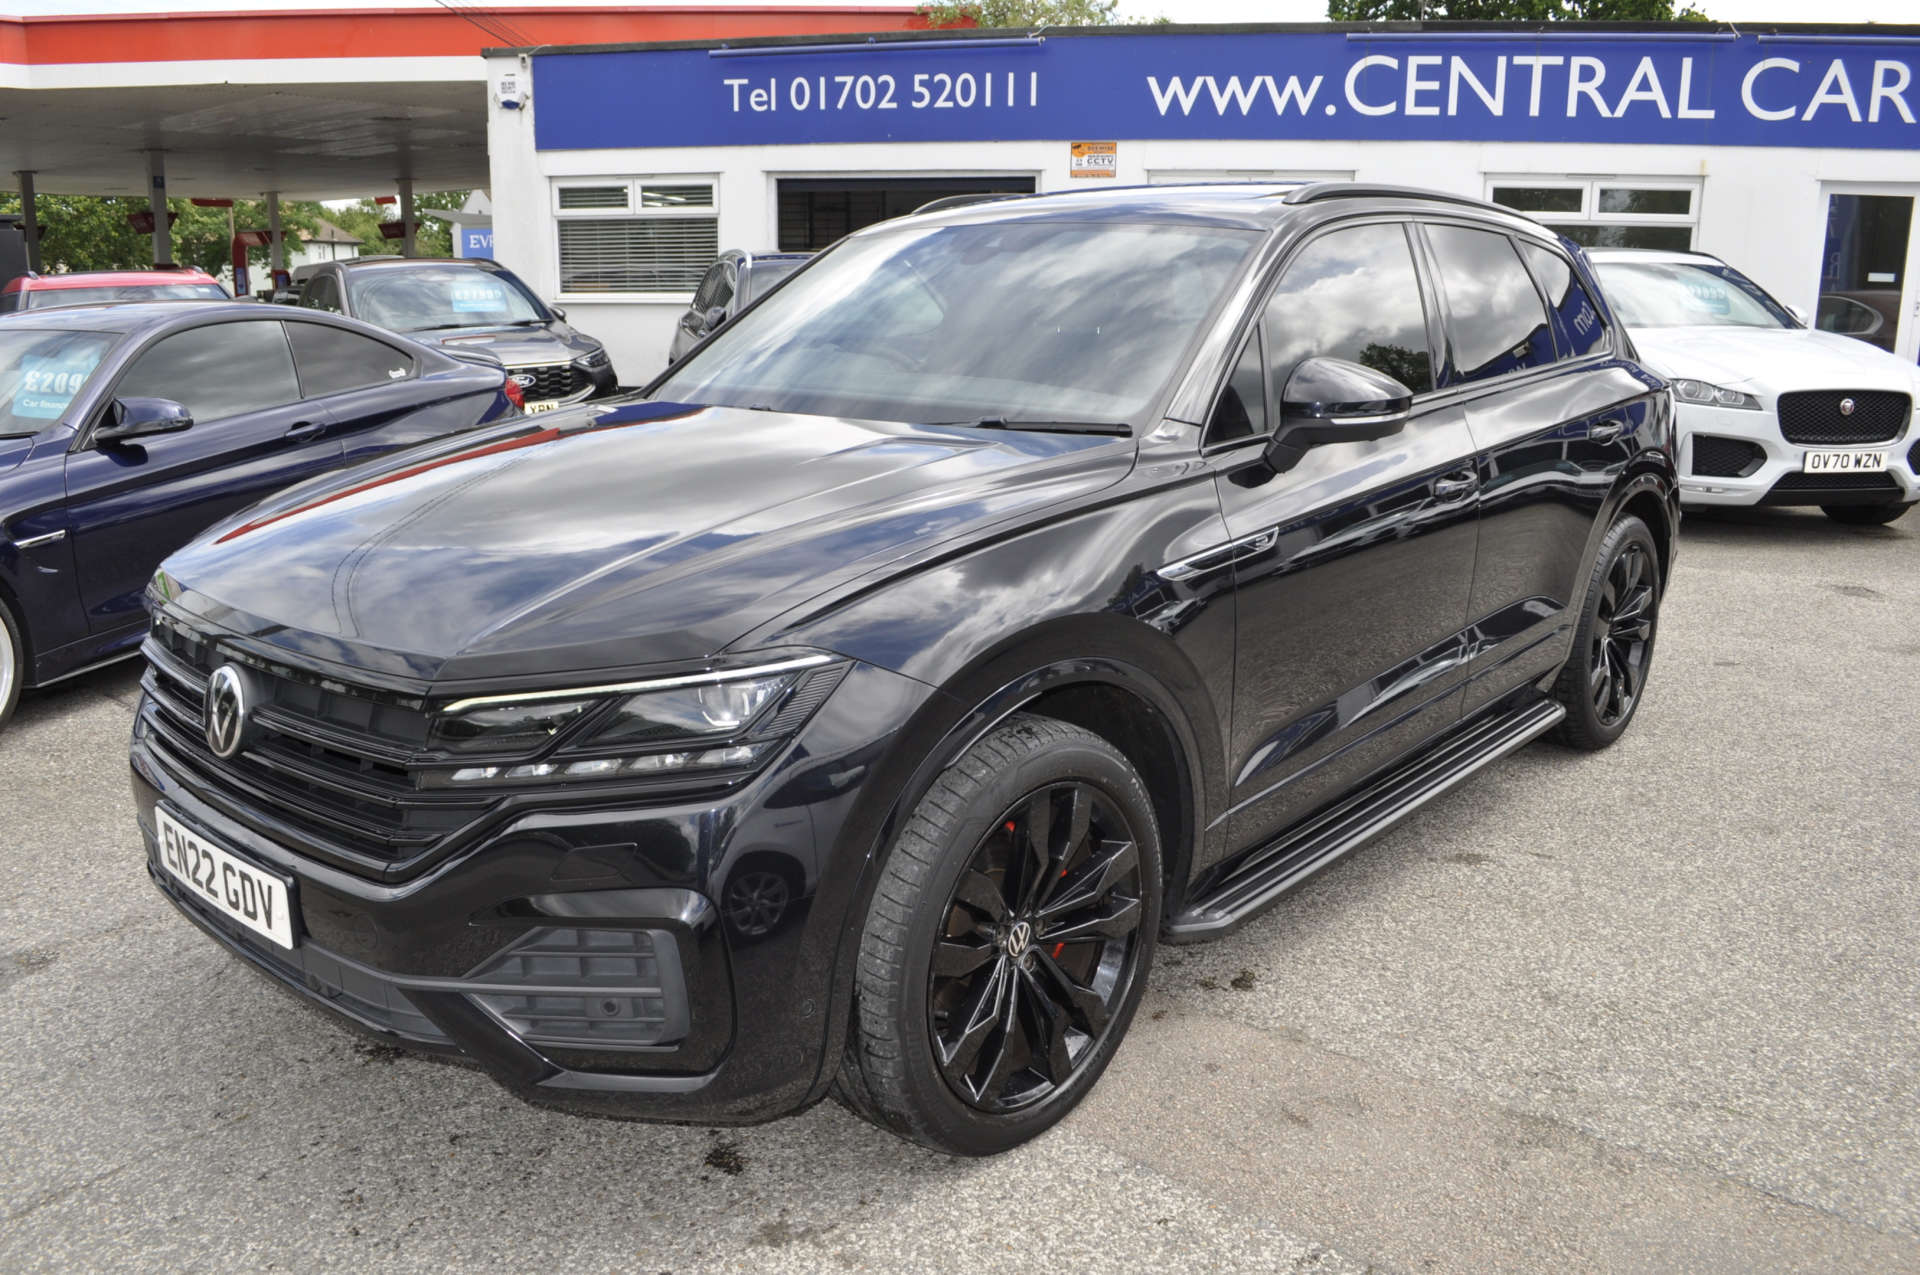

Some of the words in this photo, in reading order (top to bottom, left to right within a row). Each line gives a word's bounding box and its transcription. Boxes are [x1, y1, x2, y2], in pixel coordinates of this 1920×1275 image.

[724, 77, 776, 112] Tel
[790, 76, 898, 111] 01702
[912, 72, 1037, 108] 520111
[1741, 57, 1918, 124] CAR
[24, 370, 90, 395] £209
[1811, 454, 1850, 469] OV70
[1854, 453, 1882, 468] WZN
[163, 821, 219, 899] EN22
[222, 861, 273, 930] GDV
